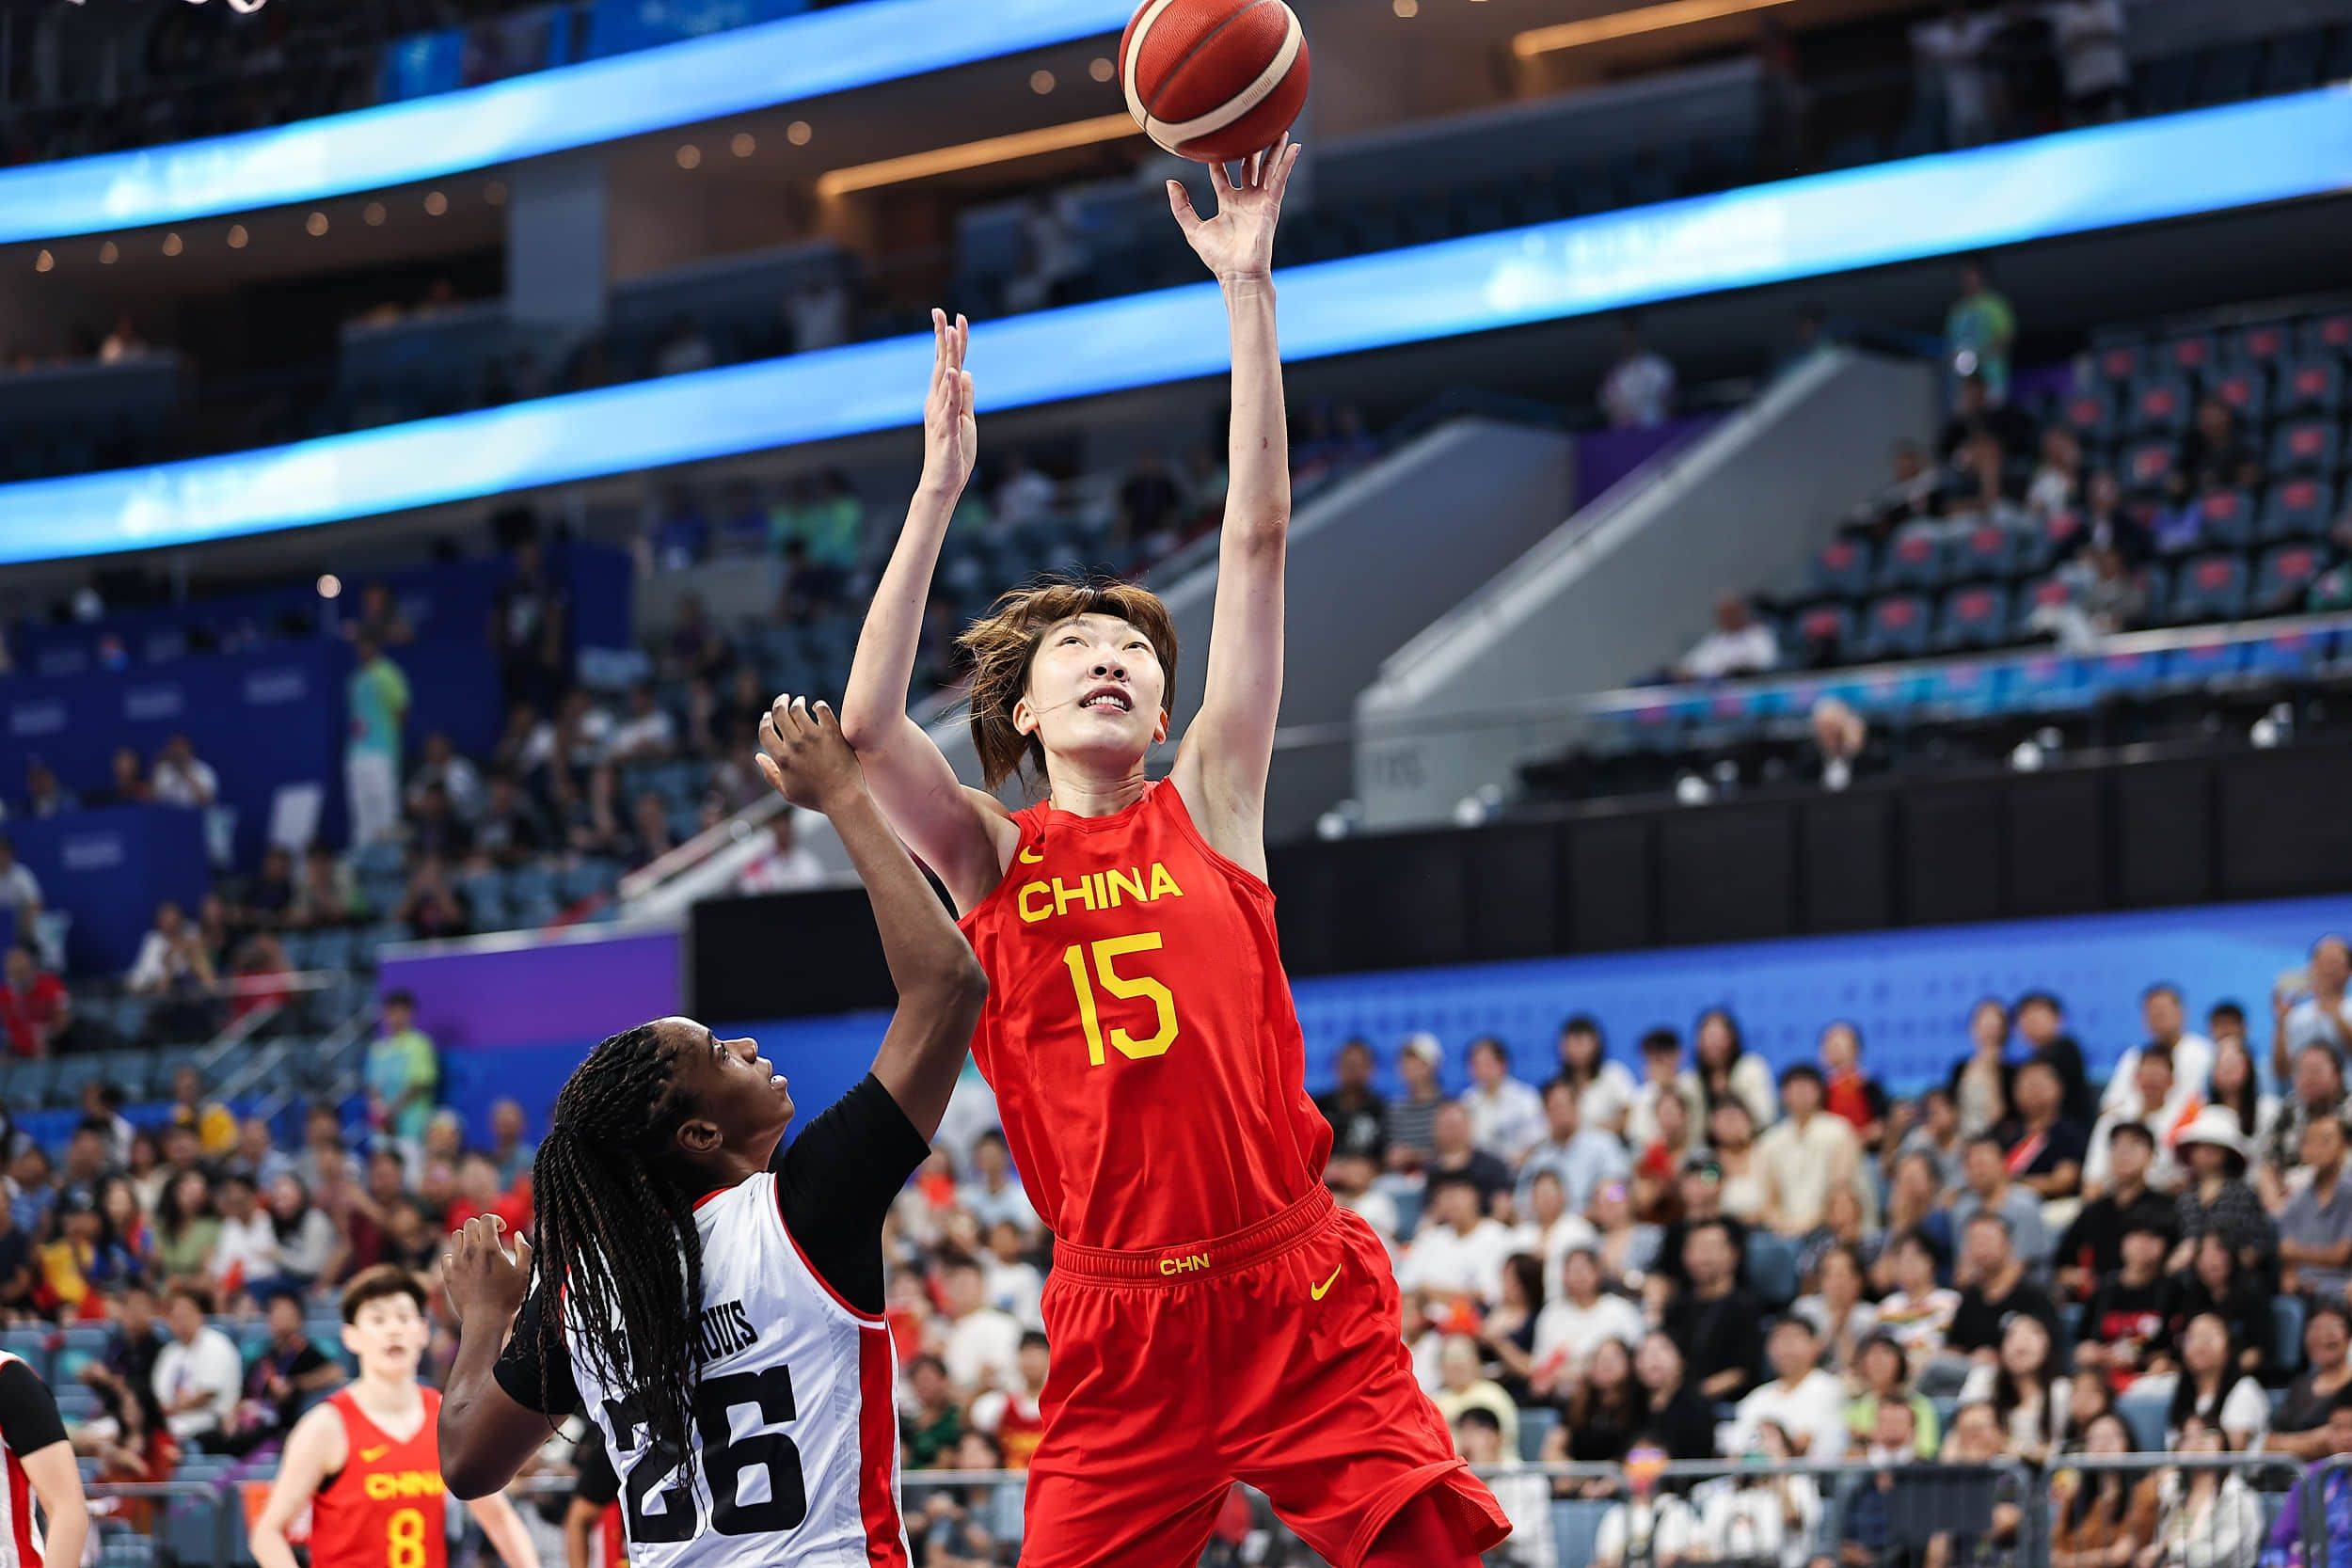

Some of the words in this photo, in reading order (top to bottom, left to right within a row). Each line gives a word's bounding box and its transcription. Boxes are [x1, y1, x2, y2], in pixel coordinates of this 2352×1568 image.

[1018, 863, 1184, 923] CHINA
[1063, 932, 1179, 1067] 15
[1160, 1253, 1210, 1275] CHN
[699, 1299, 758, 1362] OUIS
[601, 1364, 807, 1543] 26
[388, 1507, 426, 1568] 8
